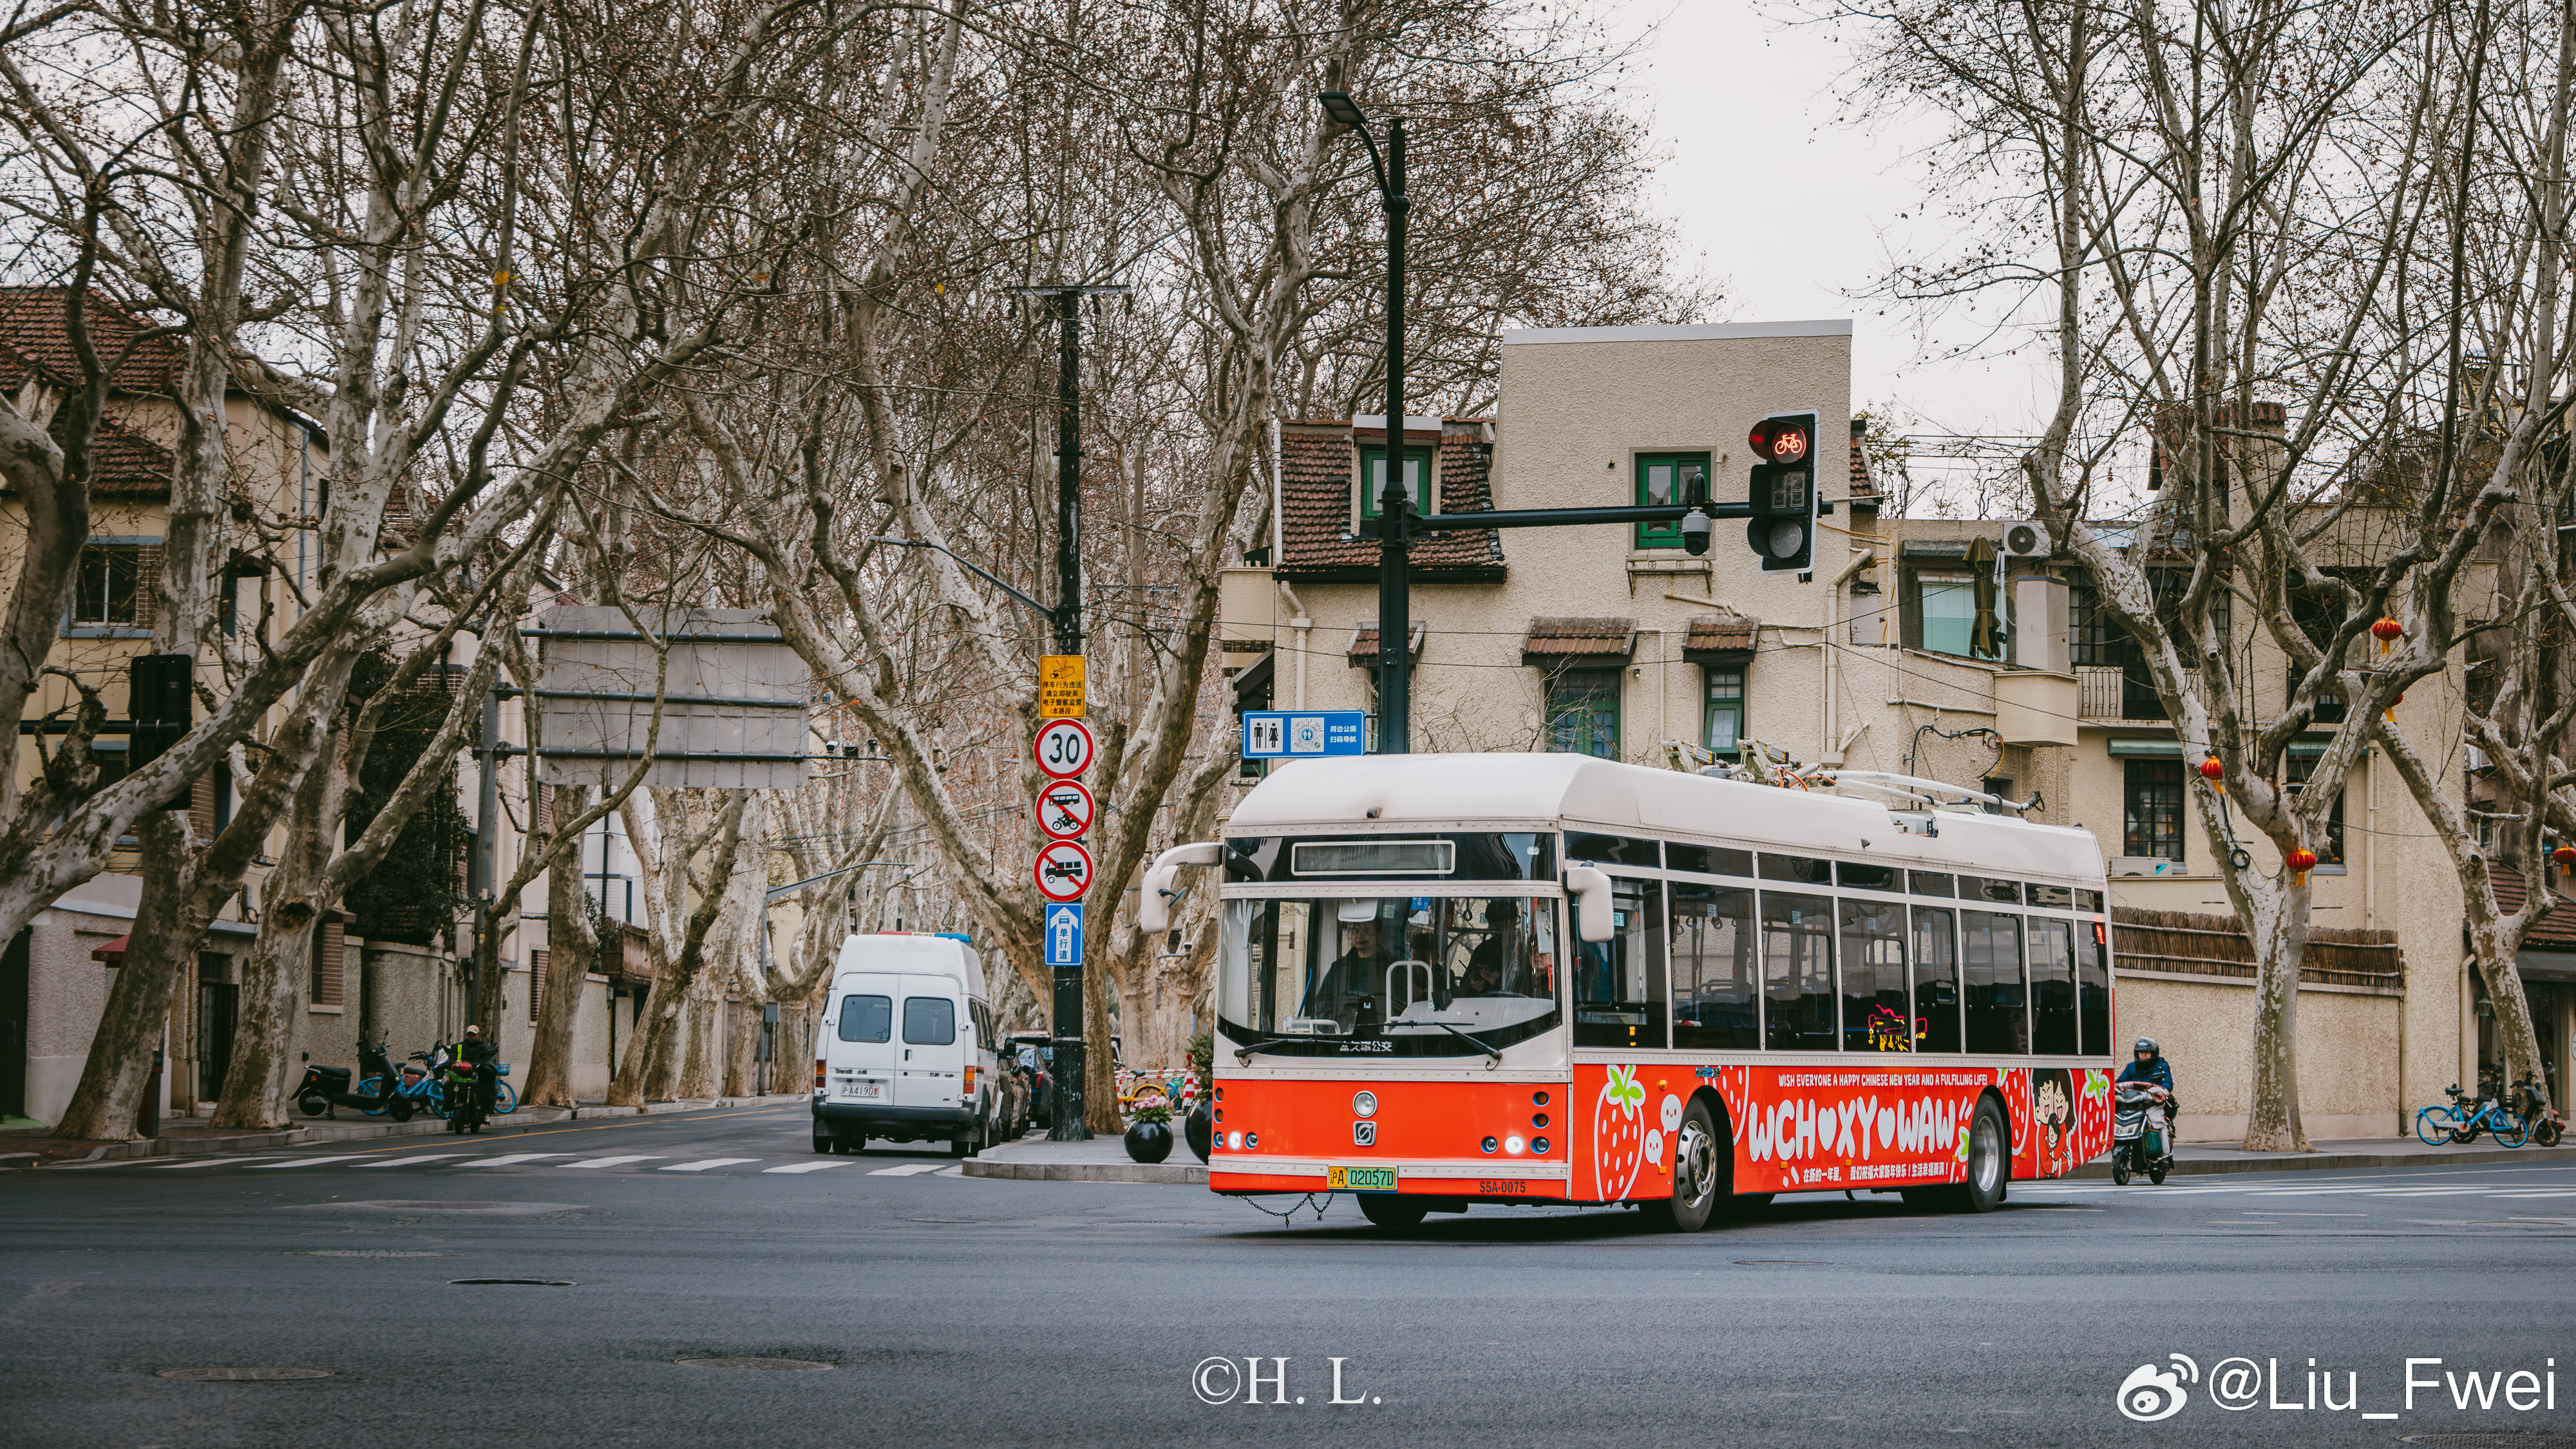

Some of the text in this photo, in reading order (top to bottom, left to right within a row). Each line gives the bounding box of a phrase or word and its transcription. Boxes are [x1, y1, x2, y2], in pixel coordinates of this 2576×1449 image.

[1048, 733, 1080, 764] 30
[1059, 927, 1068, 960] 单行道
[1778, 1074, 1987, 1087] WISH EVERYONE A HAPPY CHINESE NEW YEAR AND A FULFILLING LIFE!
[1479, 1181, 1526, 1193] S5A-0075
